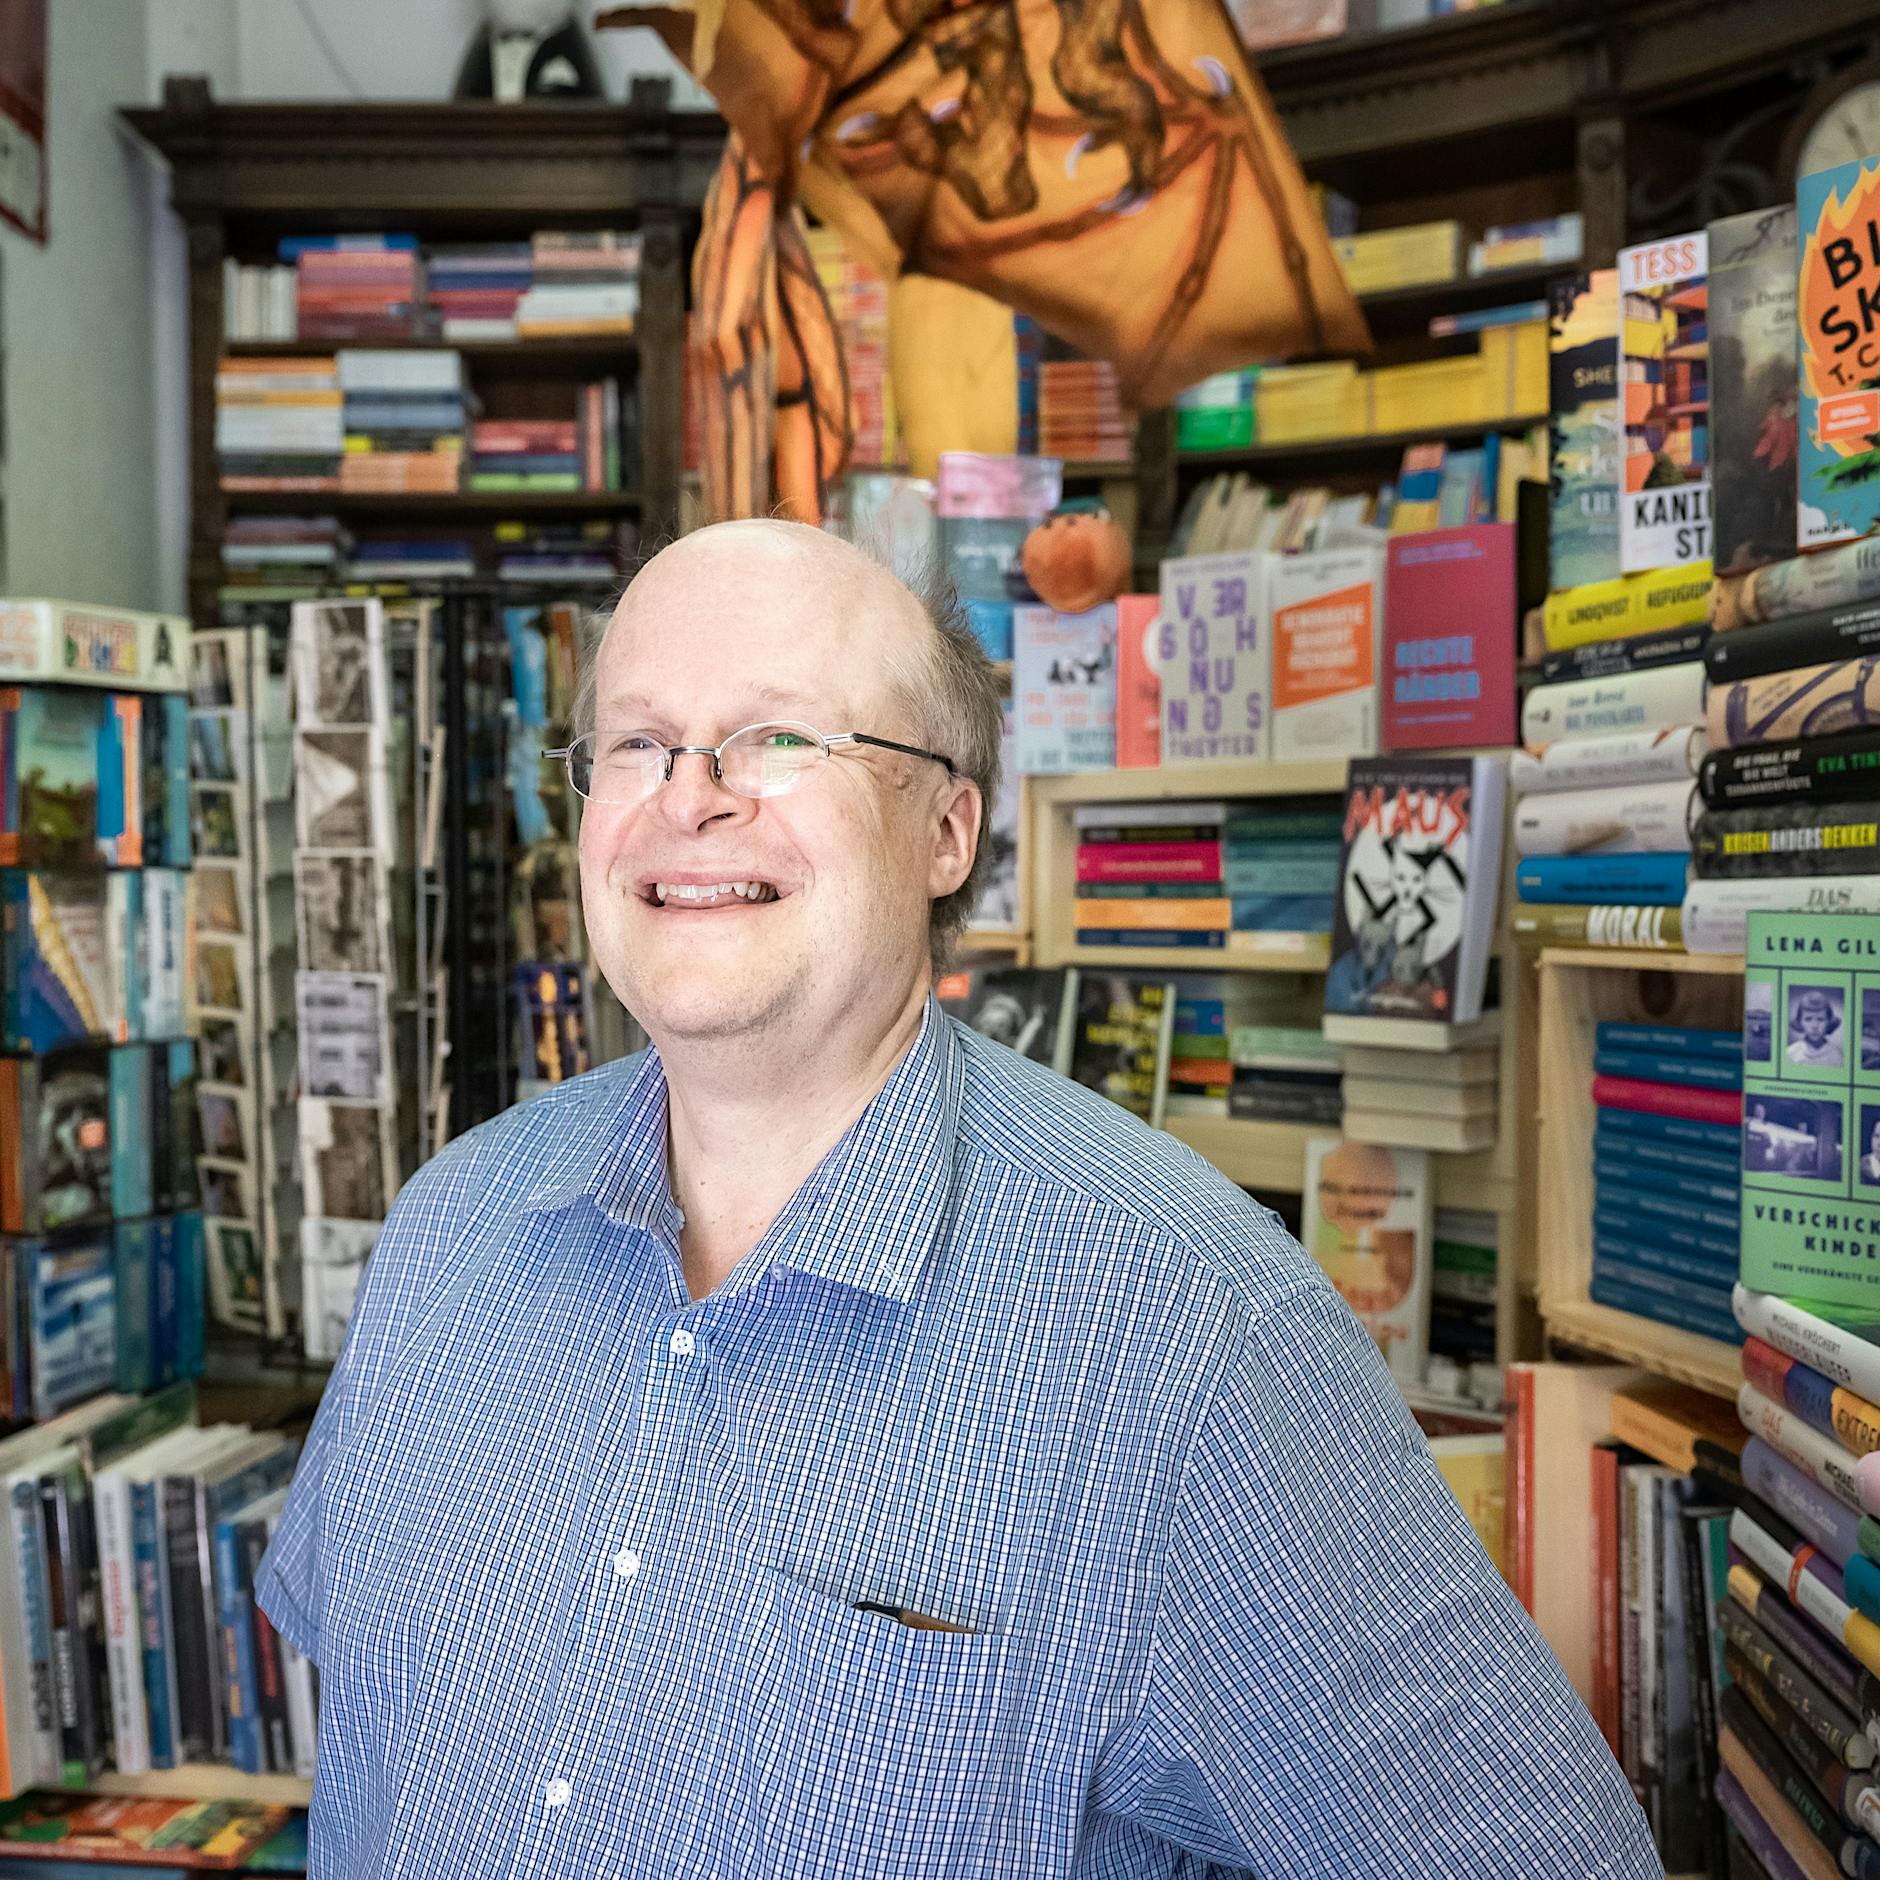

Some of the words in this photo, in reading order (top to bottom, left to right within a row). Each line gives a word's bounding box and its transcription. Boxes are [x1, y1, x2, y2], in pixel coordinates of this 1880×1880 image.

[1630, 239, 1698, 283] TESS
[1573, 365, 1615, 389] SHE
[1634, 489, 1711, 529] KANI
[1676, 527, 1711, 559] ST
[1817, 756, 1847, 774] EVA
[1852, 750, 1880, 770] TIN
[1342, 786, 1473, 853] MAUS
[1588, 905, 1667, 947] MORAL
[1767, 936, 1823, 953] LENA
[1837, 939, 1877, 954] GIL
[1805, 1236, 1876, 1260] KINDE
[1773, 1261, 1793, 1273] EINE
[1773, 1313, 1800, 1337] MICHAEL
[1837, 1408, 1880, 1454] EXTRE
